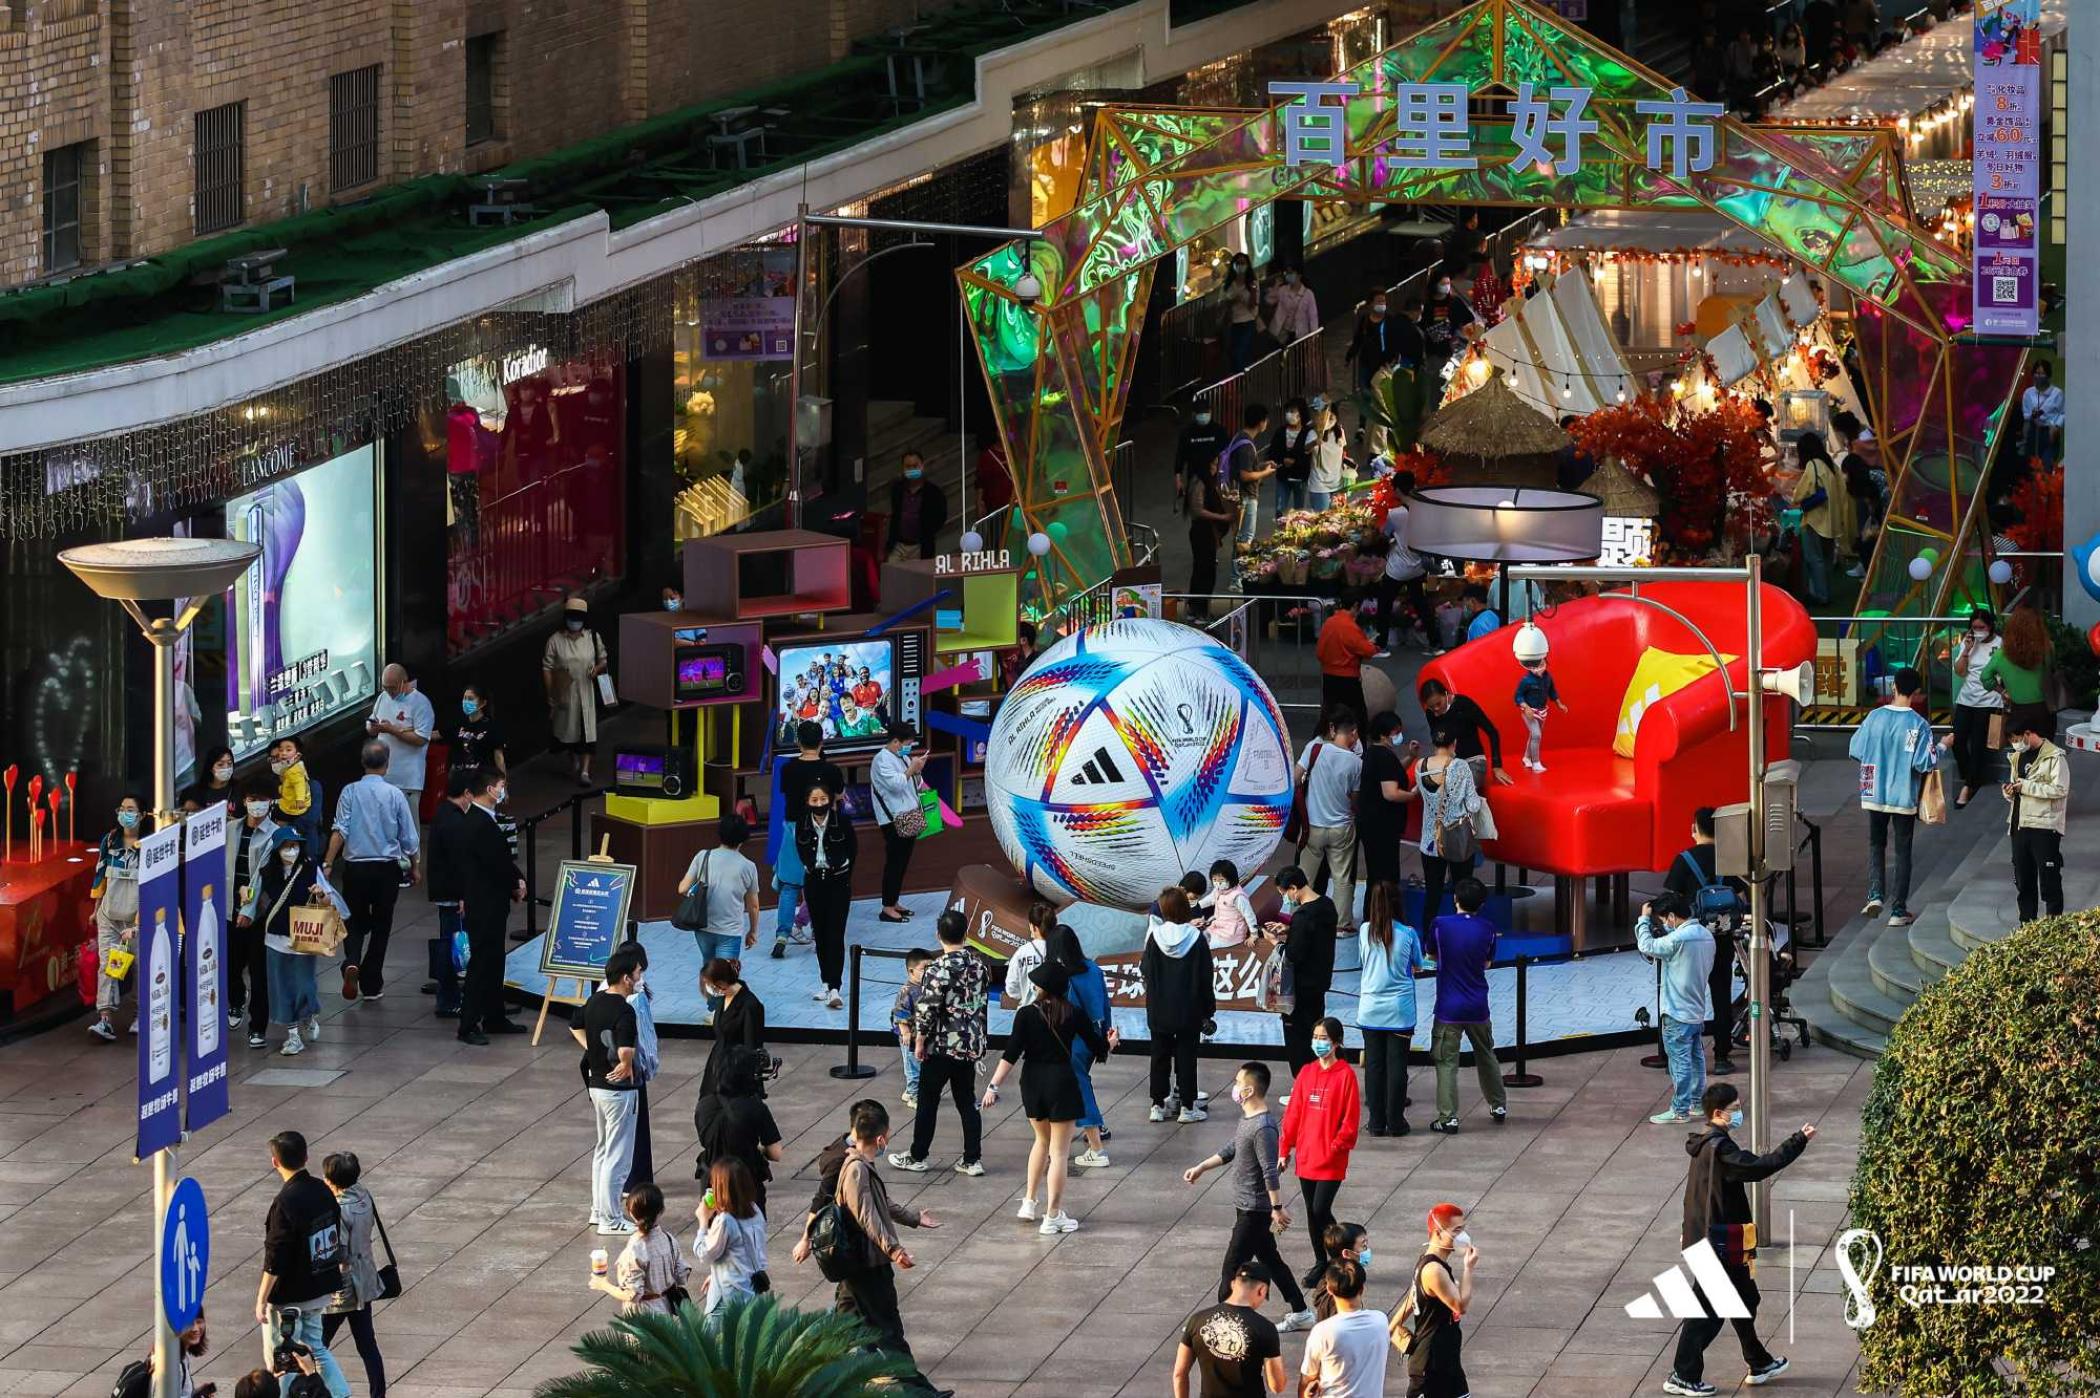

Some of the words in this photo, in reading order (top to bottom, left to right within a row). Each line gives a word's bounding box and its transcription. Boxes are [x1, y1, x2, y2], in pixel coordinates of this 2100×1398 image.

[1268, 82, 1724, 178] 百里好市
[503, 343, 548, 386] Koradior
[935, 553, 955, 574] AL
[961, 548, 1010, 572] RIHLA
[293, 920, 324, 936] MUJI
